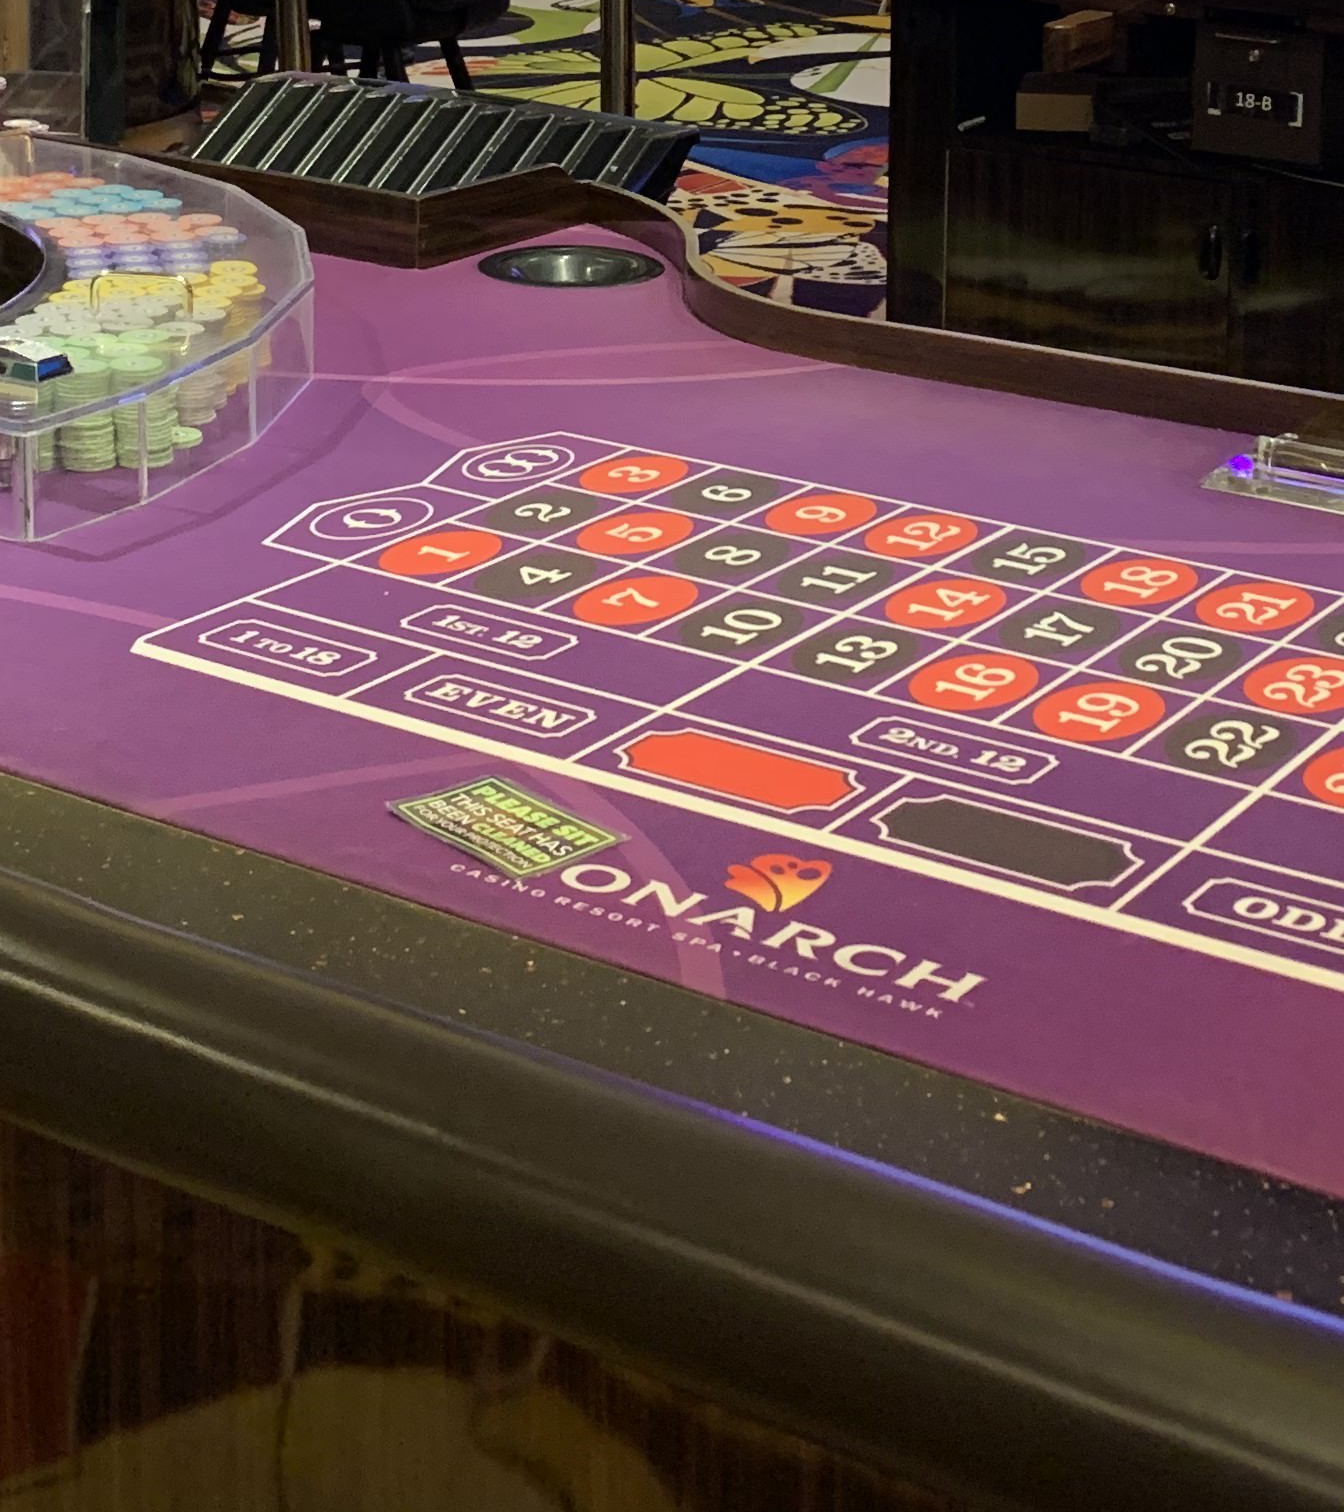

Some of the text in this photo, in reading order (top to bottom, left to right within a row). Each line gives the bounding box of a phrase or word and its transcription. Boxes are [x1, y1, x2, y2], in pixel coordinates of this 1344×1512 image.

[608, 466, 659, 482] 3
[702, 486, 751, 501] 6
[515, 503, 570, 522] 2
[796, 506, 846, 522] 9
[606, 524, 662, 542] 5
[887, 522, 960, 550] 12
[419, 546, 469, 561] 1
[705, 546, 761, 565] 8
[993, 543, 1065, 575] 15
[520, 567, 571, 584] 4
[801, 566, 876, 593] 11
[1104, 567, 1177, 598] 18
[603, 588, 658, 607] 7
[909, 589, 990, 620] 14
[1217, 593, 1296, 624] 21
[493, 631, 542, 648] 12
[701, 610, 781, 644] 10
[1025, 612, 1093, 646] 17
[230, 630, 258, 645] 1
[290, 647, 340, 665] 18
[816, 636, 897, 672] 13
[1136, 637, 1222, 679] 20
[936, 664, 1015, 700] 16
[426, 683, 575, 728] EVEN
[1060, 693, 1139, 731] 19
[1185, 721, 1279, 767] 22
[971, 751, 1026, 772] 12
[450, 793, 573, 856] THIS SEAT HAS
[471, 785, 600, 846] PLEASE SIT
[428, 800, 552, 864] BEEN CLEANED
[559, 863, 987, 1003] ONARCH
[554, 895, 660, 933] RESORT
[671, 931, 724, 953] SPA
[747, 953, 844, 988] BLACK
[856, 987, 944, 1019] HAWK
